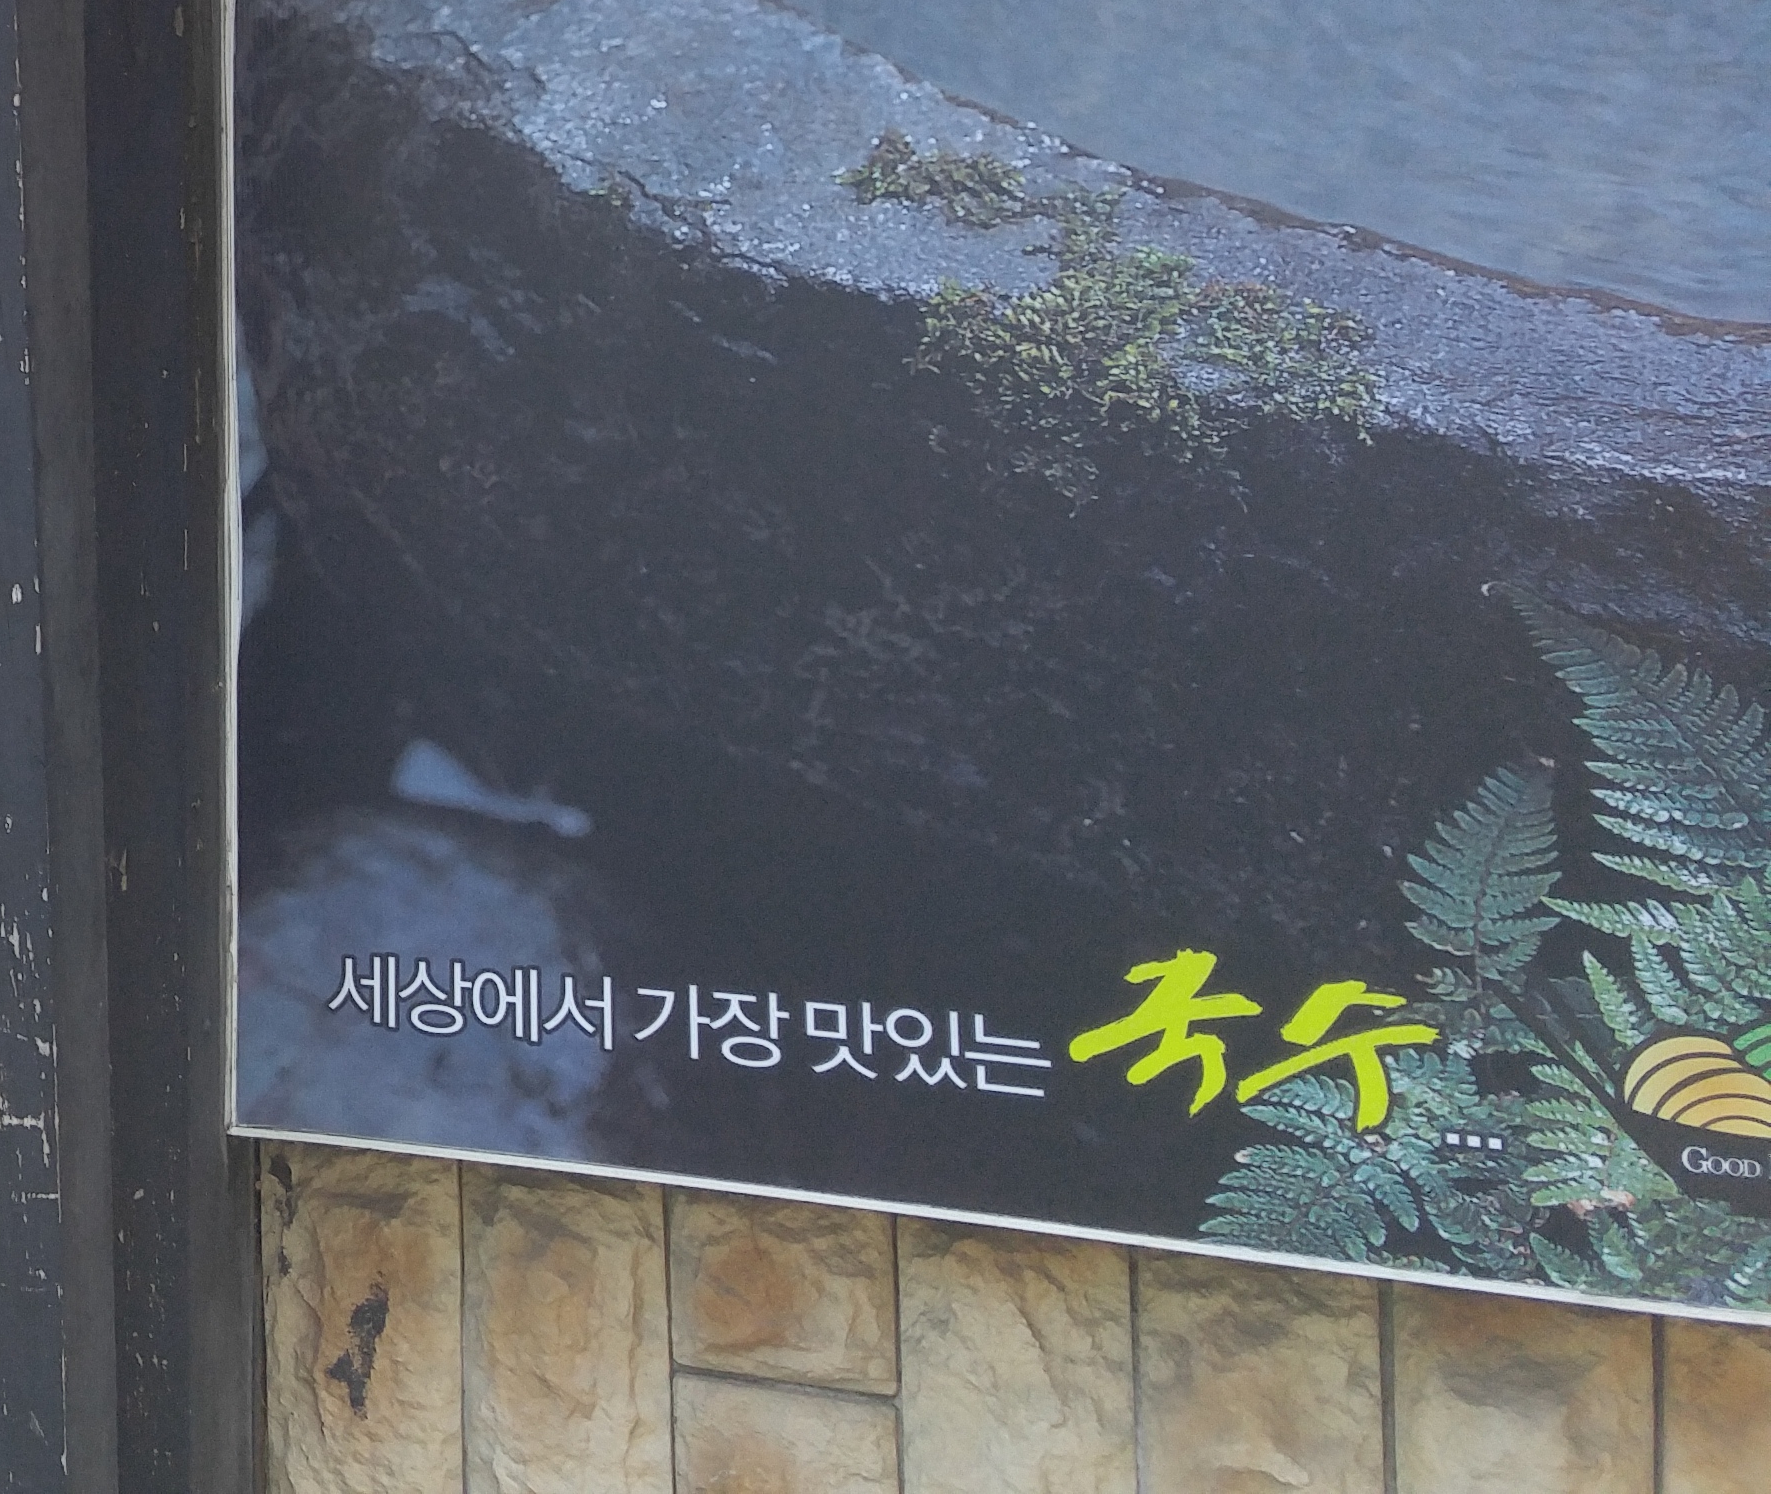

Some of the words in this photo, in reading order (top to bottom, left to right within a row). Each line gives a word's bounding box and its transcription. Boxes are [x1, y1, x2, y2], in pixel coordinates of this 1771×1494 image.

[329, 955, 614, 1051] 세상에서
[634, 984, 790, 1069] 가장
[805, 1001, 1052, 1097] 맛있는
[1069, 948, 1441, 1133] 국수
